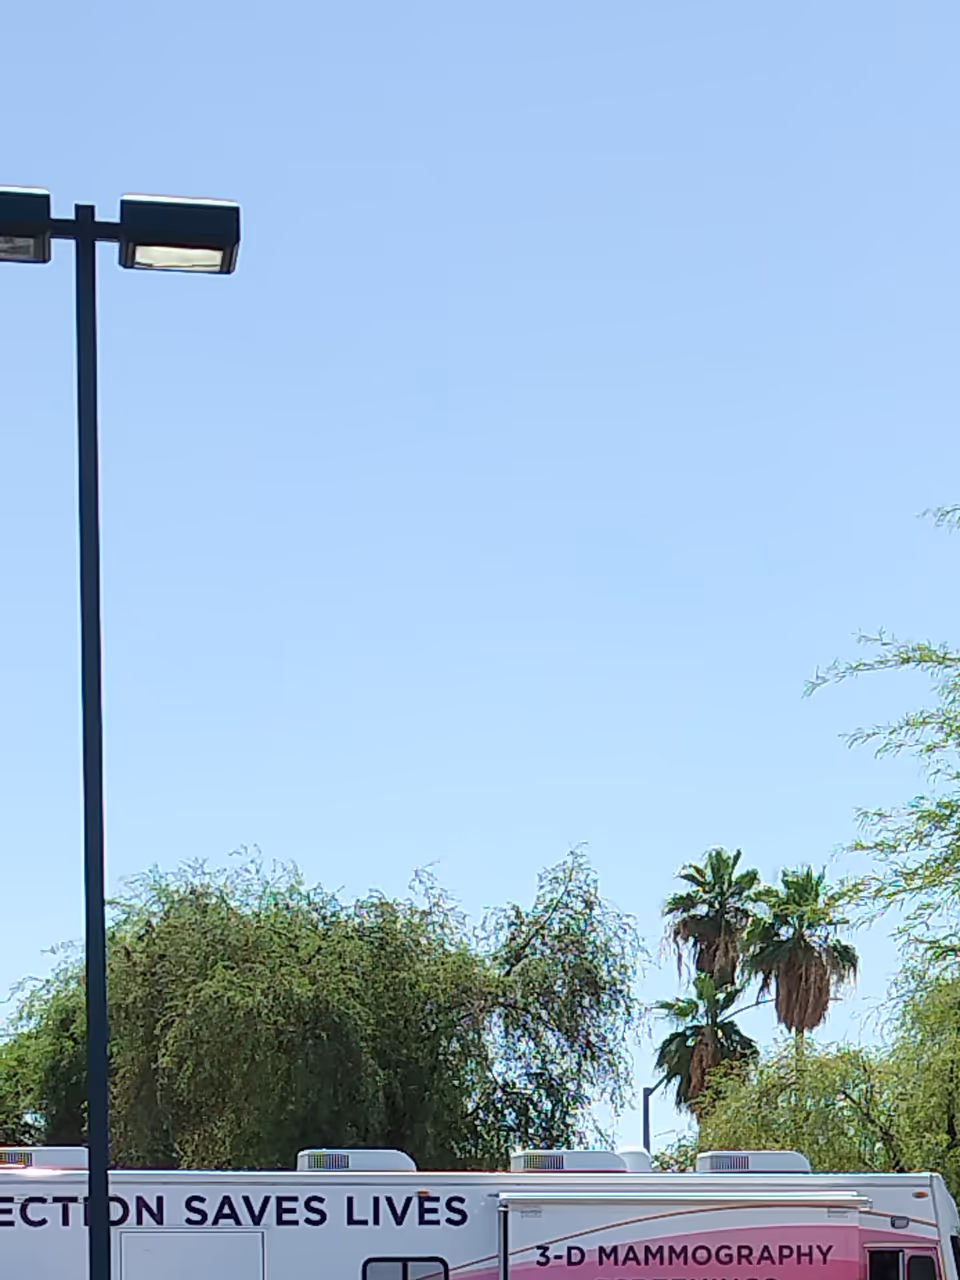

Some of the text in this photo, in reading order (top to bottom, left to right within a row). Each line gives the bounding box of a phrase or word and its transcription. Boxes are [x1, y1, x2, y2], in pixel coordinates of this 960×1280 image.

[184, 1195, 327, 1227] SAVES
[346, 1195, 469, 1227] LIVES
[535, 1244, 834, 1267] 3-D MAMMOGRAPHY
